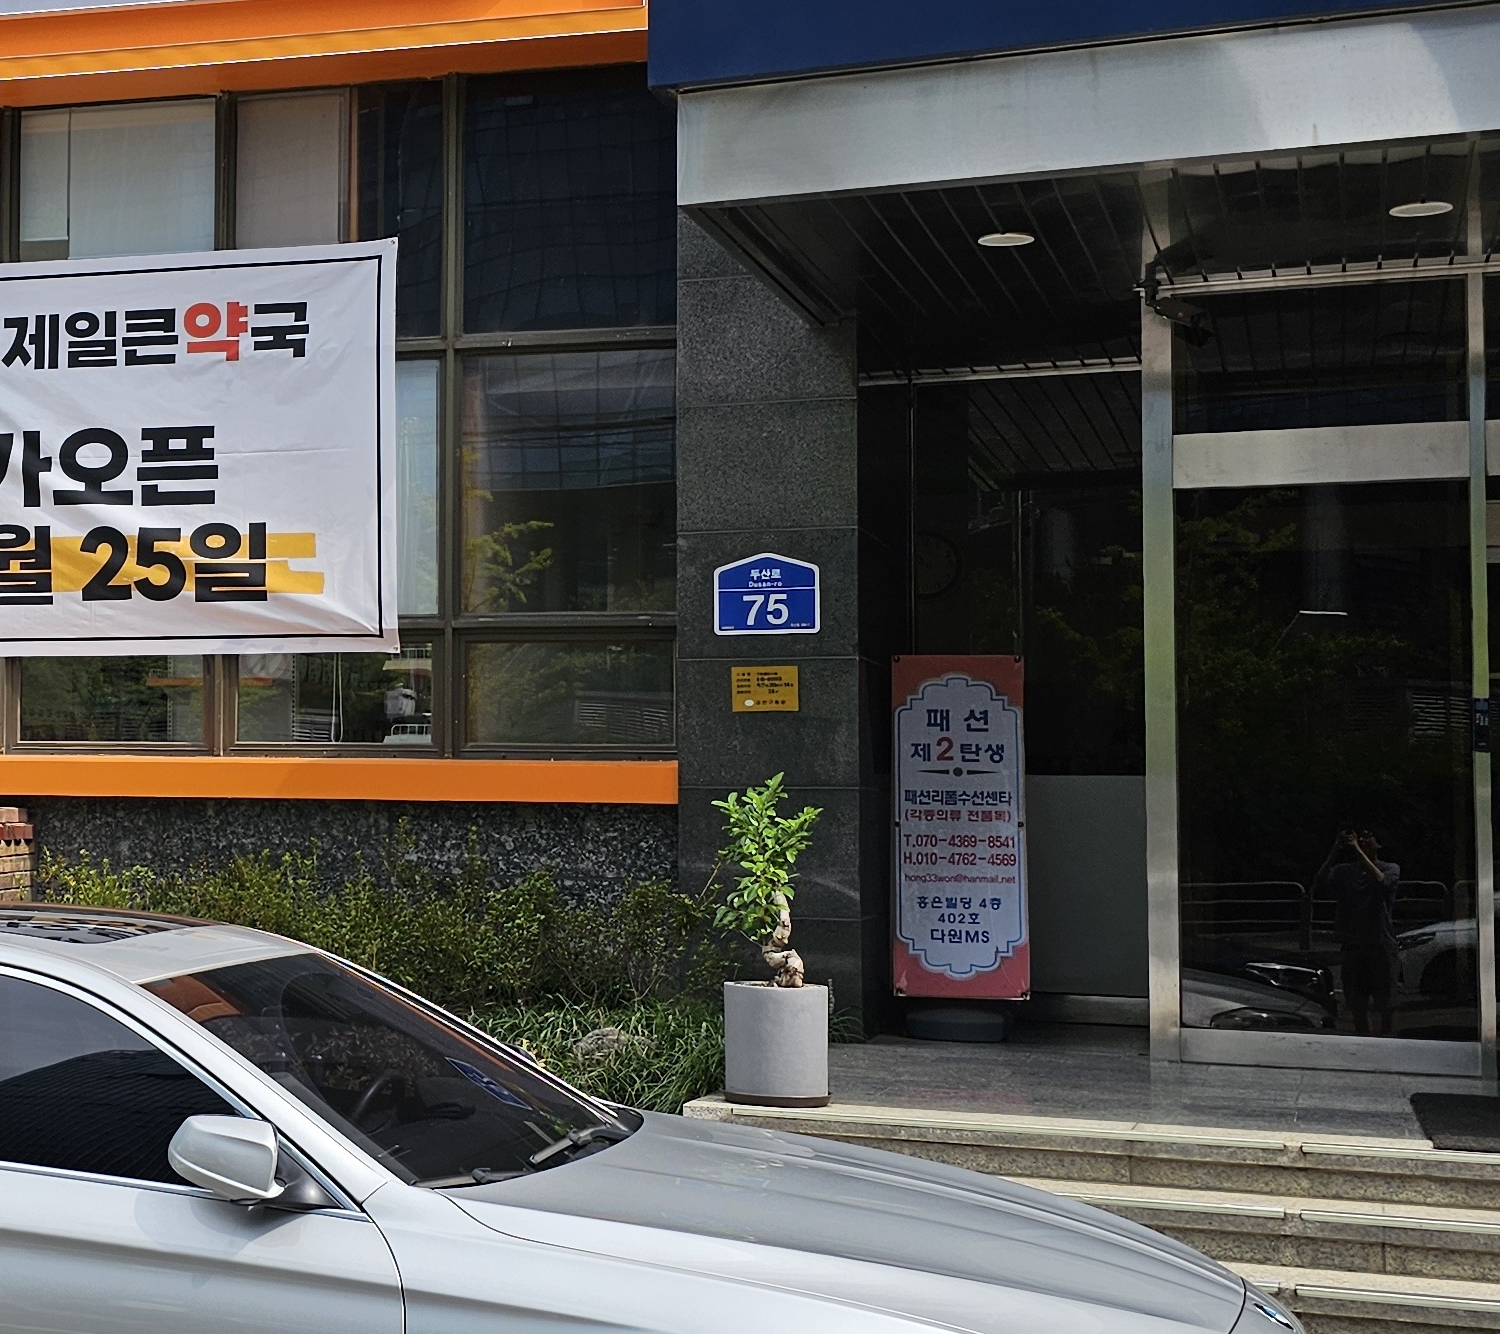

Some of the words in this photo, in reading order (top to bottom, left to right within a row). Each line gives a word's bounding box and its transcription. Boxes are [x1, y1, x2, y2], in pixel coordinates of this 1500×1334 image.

[80, 522, 269, 603] 25일
[750, 569, 781, 580] 두산로
[743, 593, 789, 626] 75
[904, 789, 1012, 806] 패션리폼수선센타
[903, 834, 1016, 849] T.070-4369-8541
[903, 851, 1017, 866] H.010-4762-4569
[979, 897, 1002, 910] 4층
[938, 913, 981, 925] 402호
[930, 929, 990, 944] 다원MS
